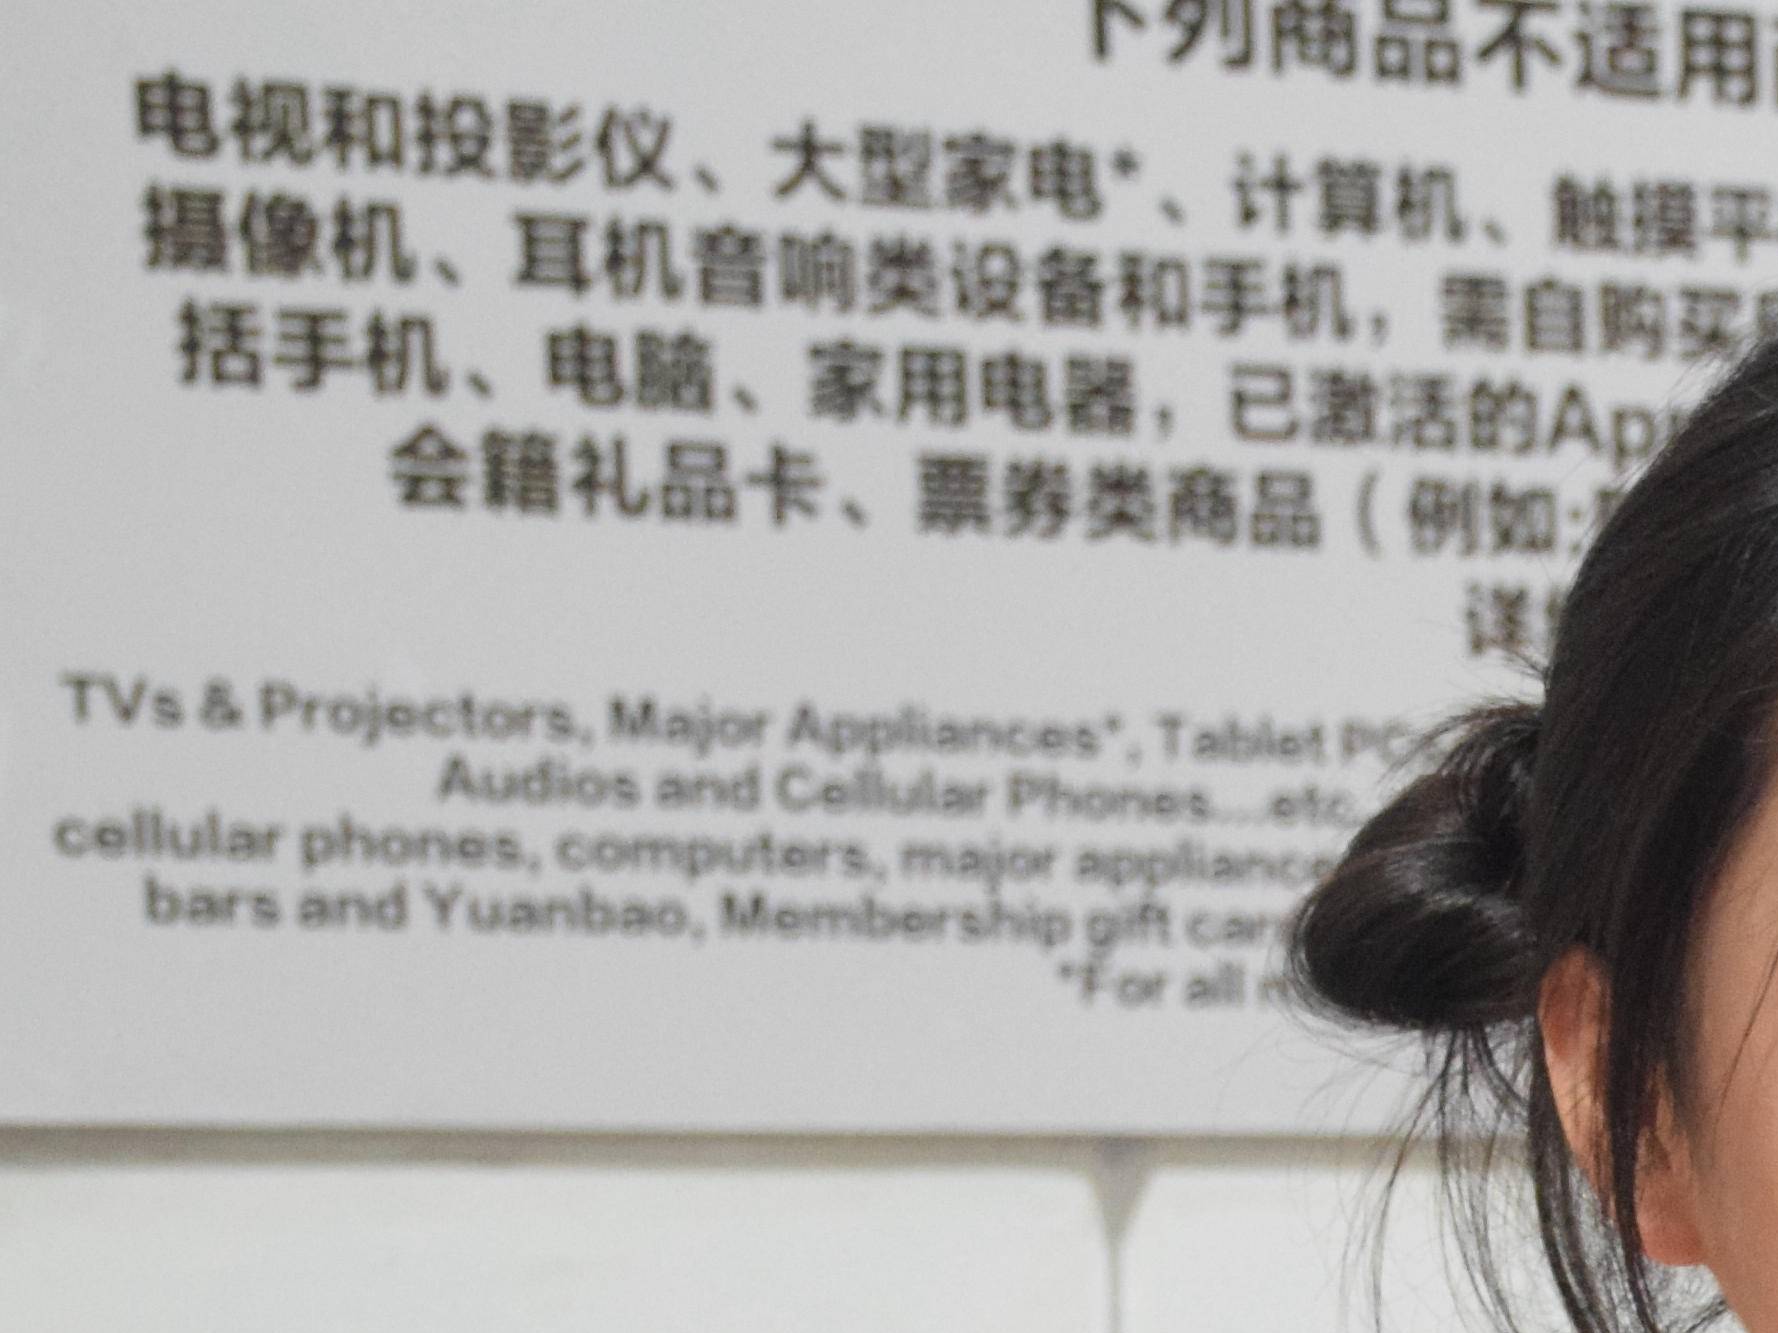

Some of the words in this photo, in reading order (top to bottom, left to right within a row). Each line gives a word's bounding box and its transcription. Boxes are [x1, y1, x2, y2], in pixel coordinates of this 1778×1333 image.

[60, 672, 183, 728] TVs
[198, 676, 243, 730] &
[259, 678, 594, 746] Projectors,
[607, 693, 768, 755] Major
[1156, 714, 1326, 762] Tablet
[436, 753, 640, 804] Audios
[655, 767, 762, 806] and
[774, 768, 990, 816] Cellular
[52, 806, 284, 862] cellular
[299, 813, 540, 874] phones,
[554, 828, 887, 884] computers,
[901, 843, 1055, 900] major
[142, 876, 281, 930] bars
[296, 885, 407, 932] and
[424, 882, 706, 944] Yuanbao,
[719, 890, 1072, 948] Membership
[1087, 904, 1170, 954] gift
[1186, 960, 1246, 1008] all
